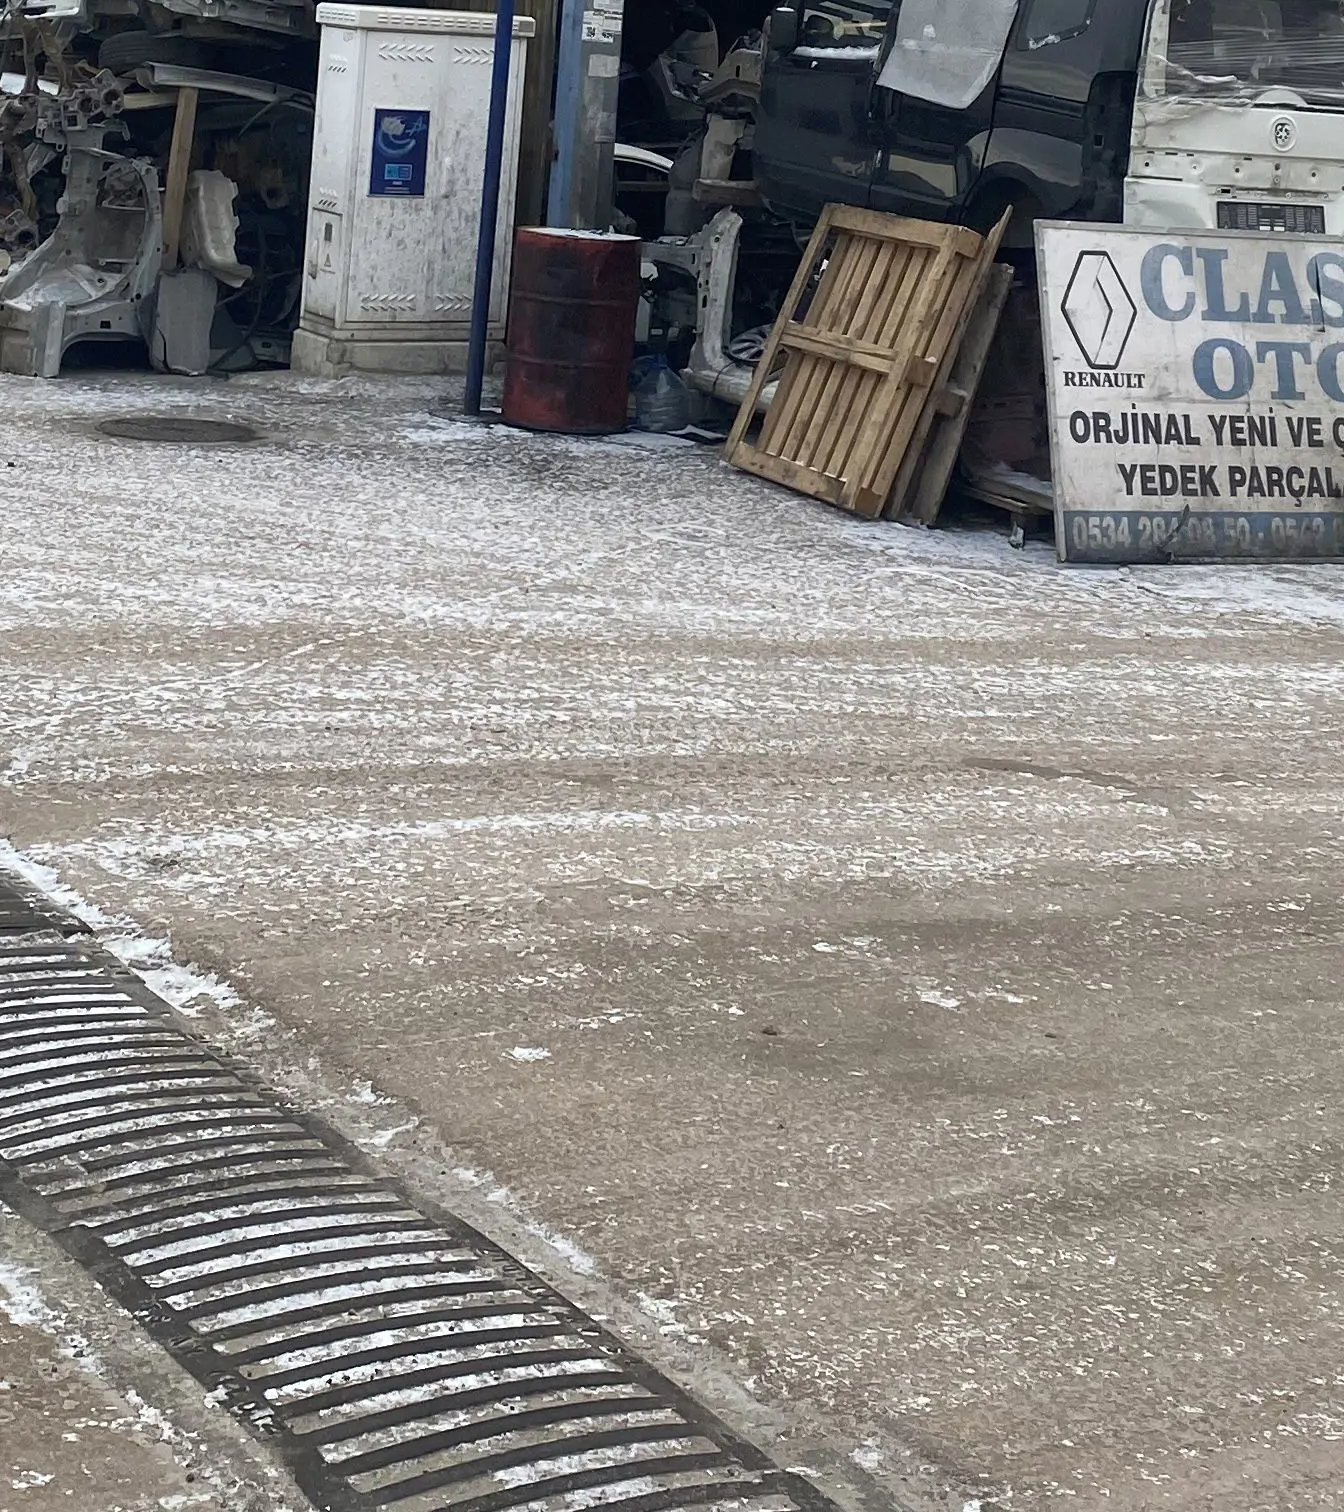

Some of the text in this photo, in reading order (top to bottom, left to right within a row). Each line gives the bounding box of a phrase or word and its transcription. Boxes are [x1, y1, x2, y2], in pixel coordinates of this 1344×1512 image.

[1063, 370, 1145, 389] RENAULT
[1069, 403, 1201, 445] ORJİNAL
[1207, 407, 1277, 447] YENİ
[1285, 416, 1324, 448] VE
[1117, 463, 1221, 497] YEDEK
[1072, 516, 1131, 549] 0534
